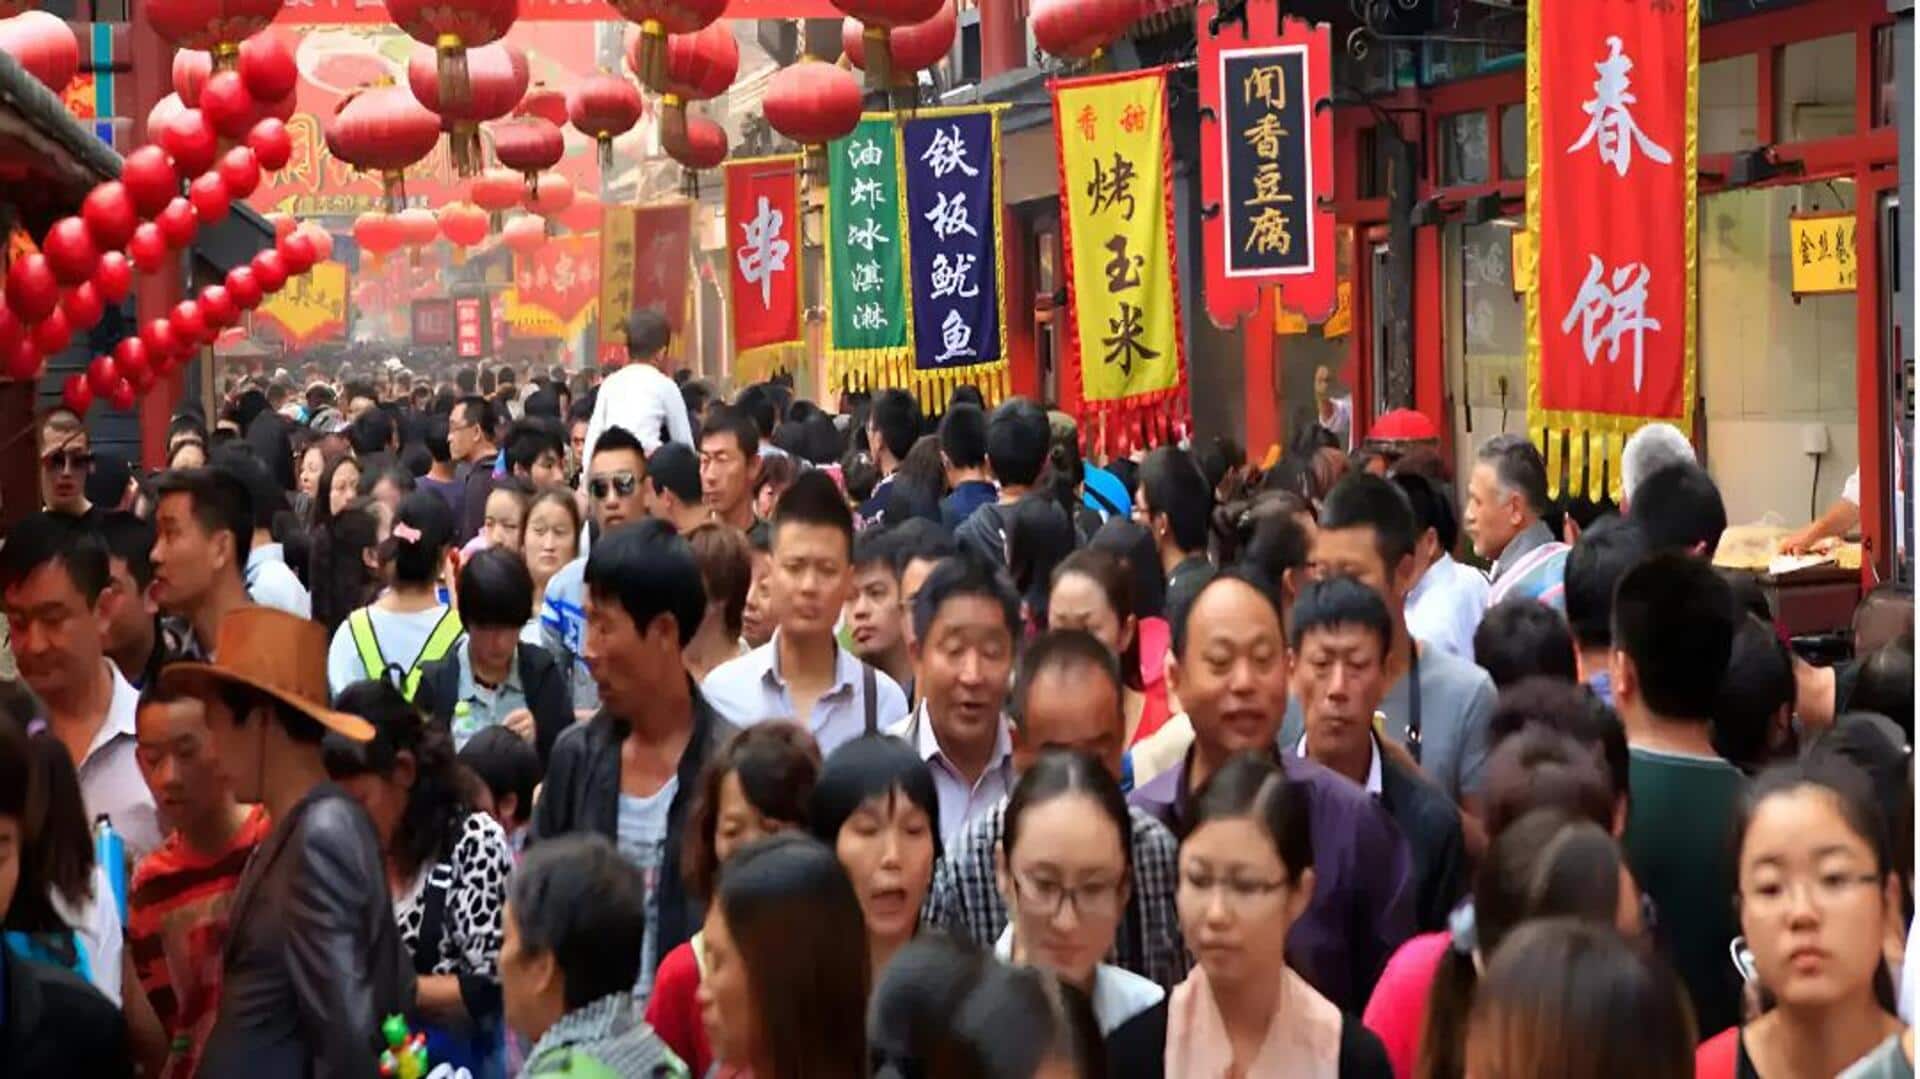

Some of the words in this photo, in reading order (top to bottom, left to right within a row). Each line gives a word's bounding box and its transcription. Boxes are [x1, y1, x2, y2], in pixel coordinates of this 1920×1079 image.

[737, 196, 790, 311] 串
[847, 138, 889, 330] 油炸冰淇淋
[920, 124, 980, 363] 铁板鱿鱼
[1087, 152, 1161, 376] 烤玉米
